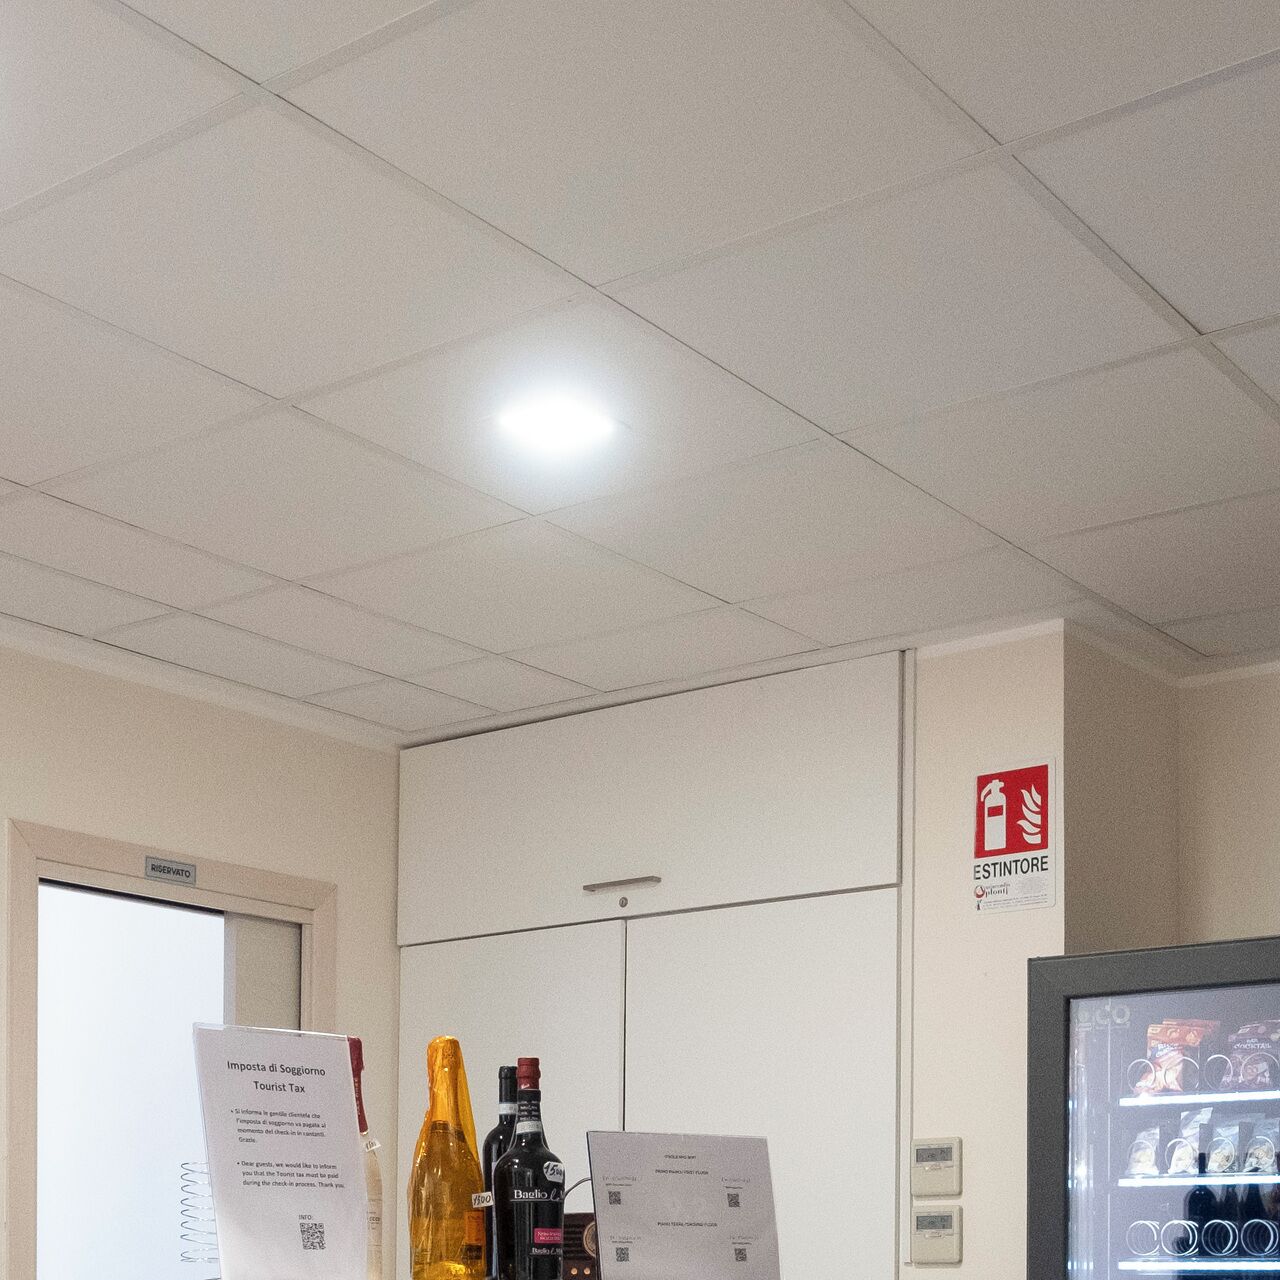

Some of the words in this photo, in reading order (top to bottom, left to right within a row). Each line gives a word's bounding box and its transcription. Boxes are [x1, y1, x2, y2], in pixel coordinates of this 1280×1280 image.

[151, 864, 190, 878] RISERVATO
[974, 856, 1048, 880] ESTINTORE
[227, 1061, 266, 1072] Imposta
[269, 1063, 277, 1073] di
[280, 1064, 326, 1076] Soggiorno
[253, 1081, 287, 1092] Tourist
[289, 1083, 306, 1093] Tax
[514, 1189, 547, 1199] Baglio
